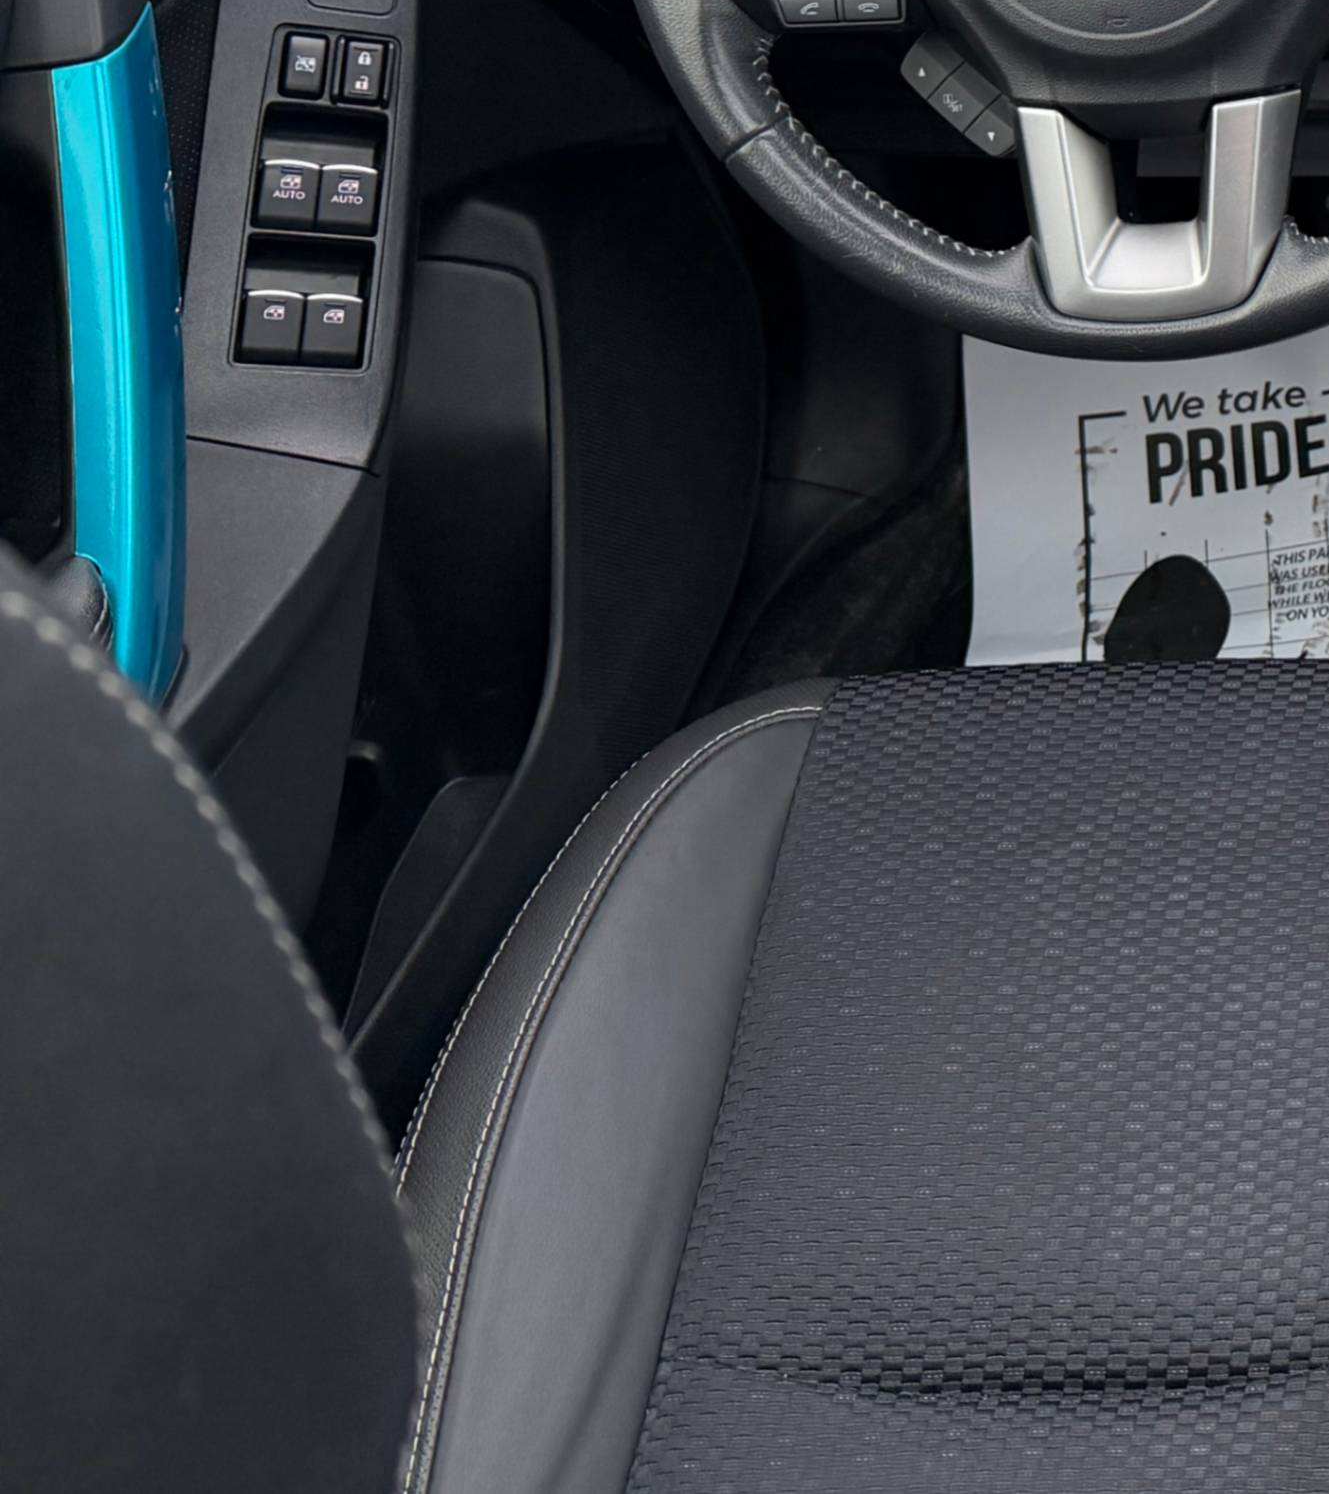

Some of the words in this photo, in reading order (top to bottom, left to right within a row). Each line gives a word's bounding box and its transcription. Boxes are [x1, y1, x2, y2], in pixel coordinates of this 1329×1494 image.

[273, 189, 307, 201] AUTO
[330, 193, 364, 206] AUTO
[1143, 391, 1205, 423] We
[1217, 380, 1307, 416] take
[1275, 550, 1305, 566] THIS
[1275, 583, 1299, 595] THE
[1271, 593, 1311, 609] WHILE
[1286, 608, 1308, 621] ON
